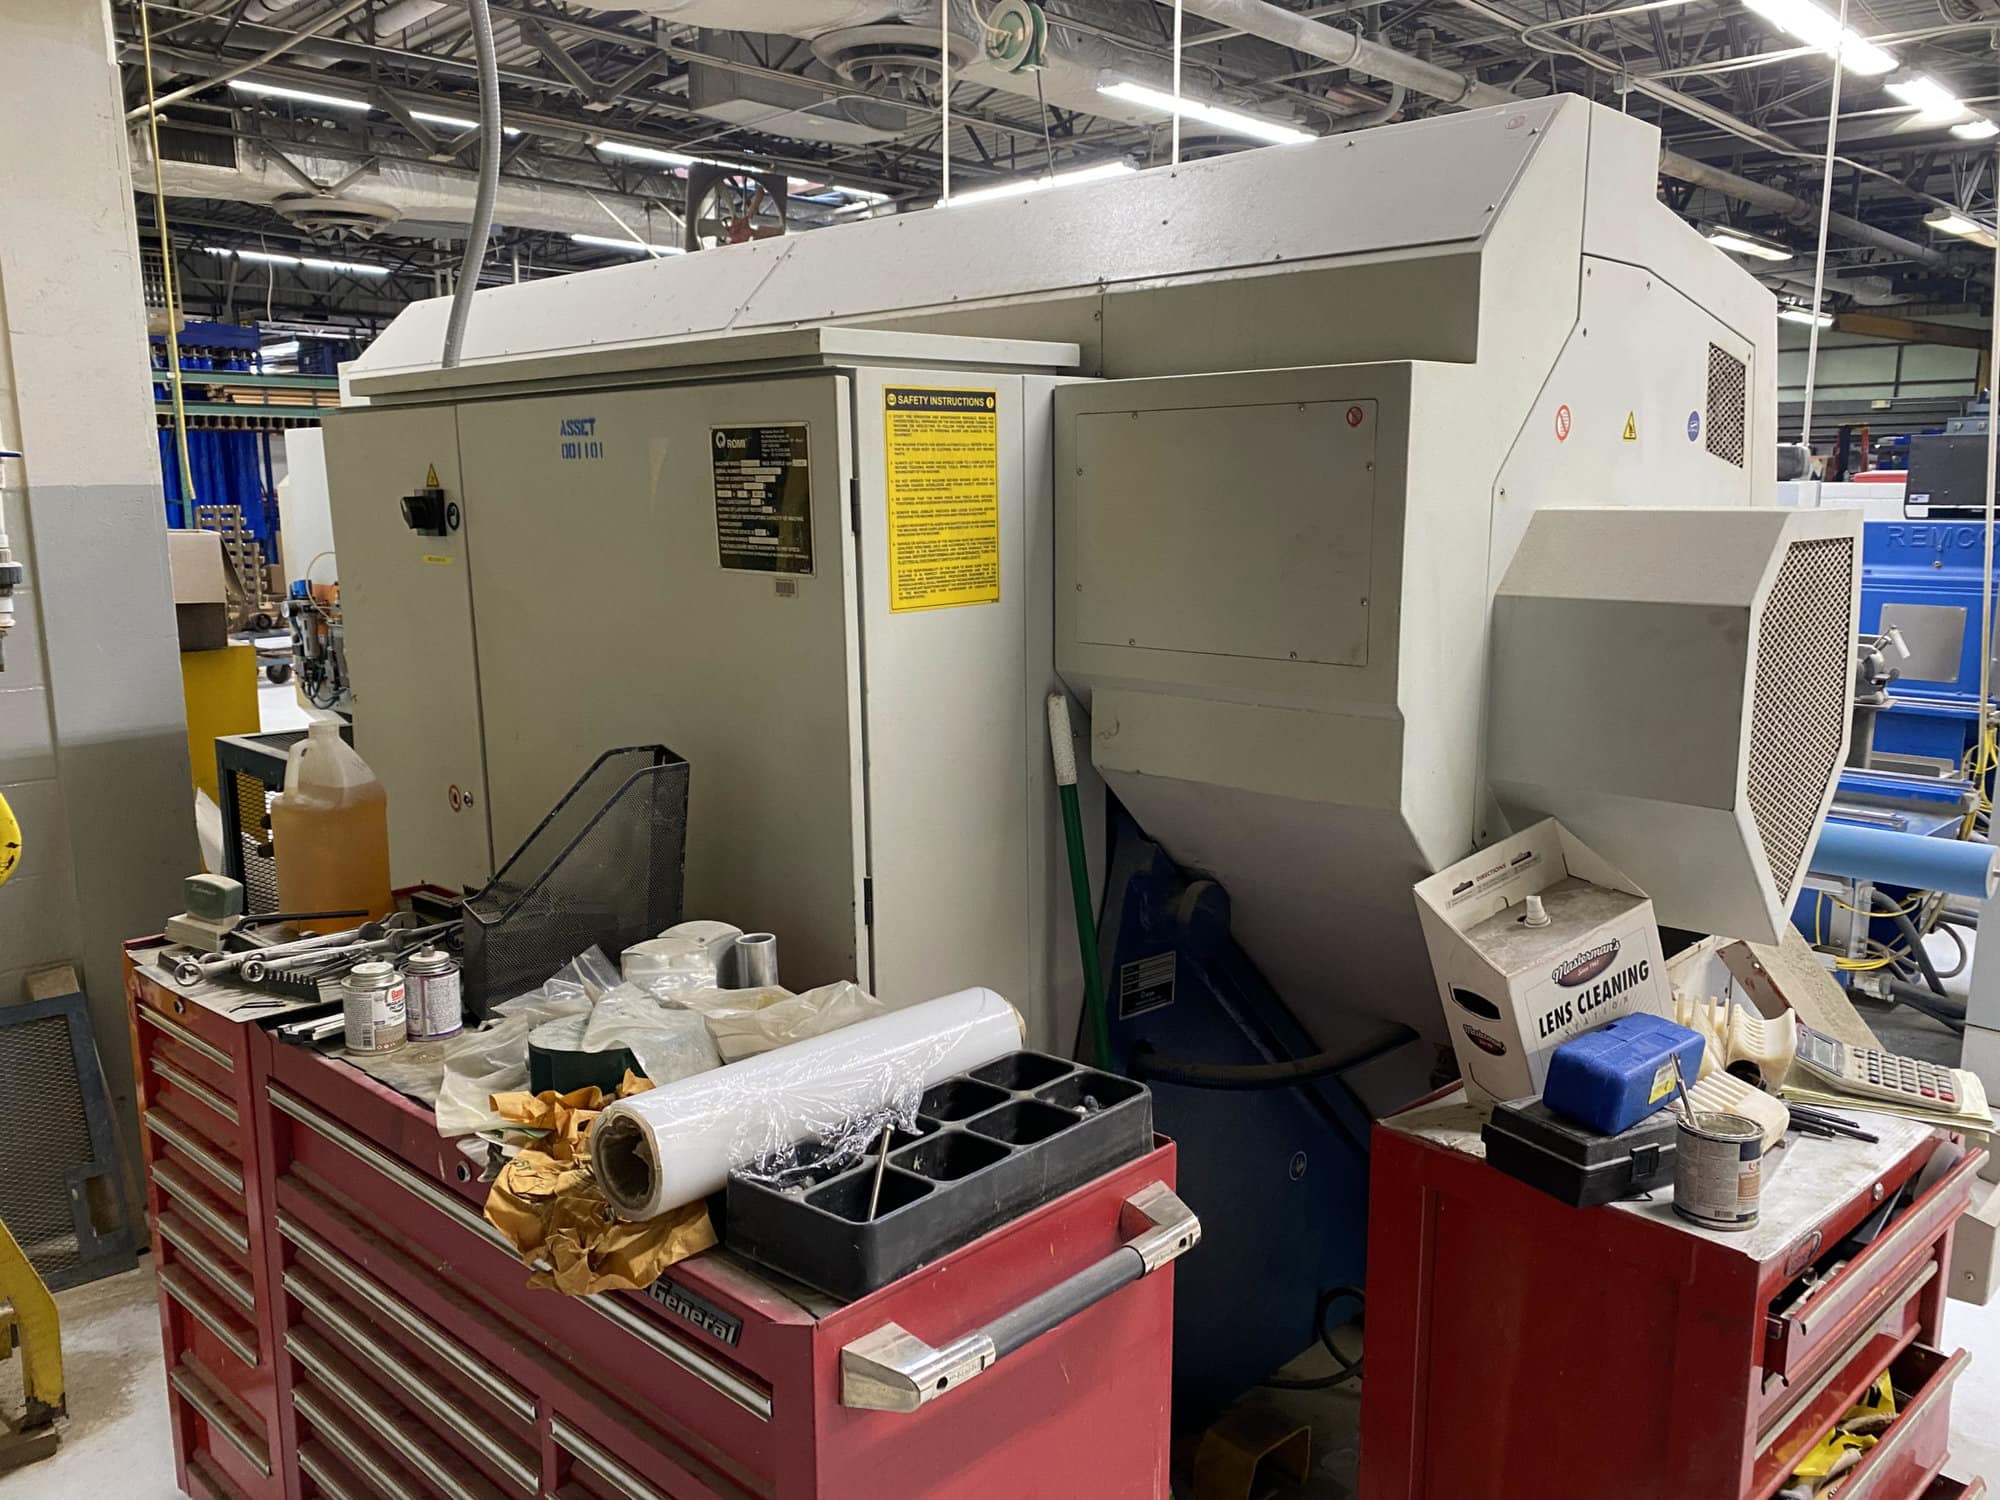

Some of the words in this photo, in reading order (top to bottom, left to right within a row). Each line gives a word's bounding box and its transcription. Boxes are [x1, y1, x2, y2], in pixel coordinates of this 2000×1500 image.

[897, 394, 928, 405] SAFETY
[930, 396, 985, 407] INSTRUCTIONS
[560, 417, 596, 436] ASSET
[561, 442, 603, 459] 001101
[727, 438, 746, 449] ROMI
[1551, 938, 1621, 985] Masterman's
[1538, 1000, 1573, 1039] LENS
[1577, 959, 1649, 1015] CLEANING
[649, 1281, 736, 1345] General
